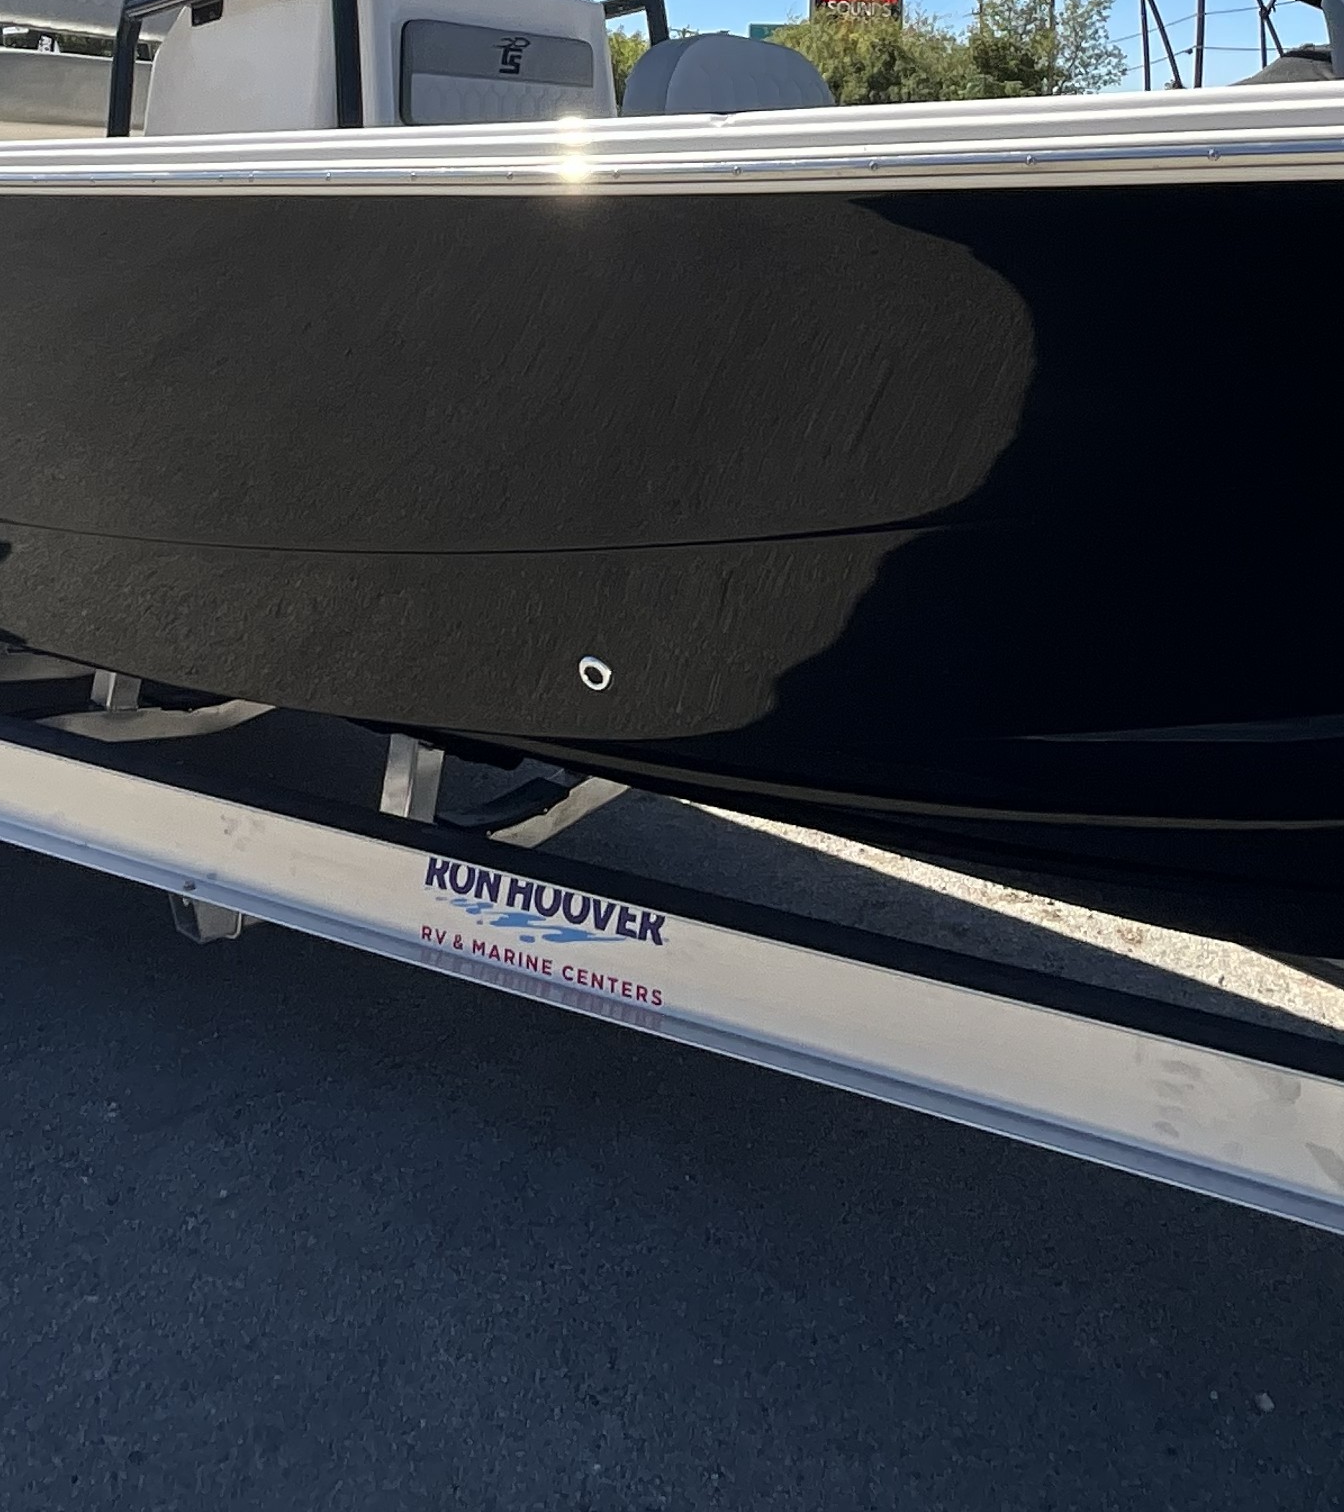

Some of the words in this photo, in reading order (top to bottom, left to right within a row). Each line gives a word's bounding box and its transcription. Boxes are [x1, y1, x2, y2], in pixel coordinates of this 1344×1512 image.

[425, 857, 501, 903] RON
[506, 877, 667, 946] HOOVER
[421, 925, 447, 946] RV
[453, 934, 464, 950] &
[472, 939, 552, 976] MARINE
[562, 965, 663, 1006] CENTERS
